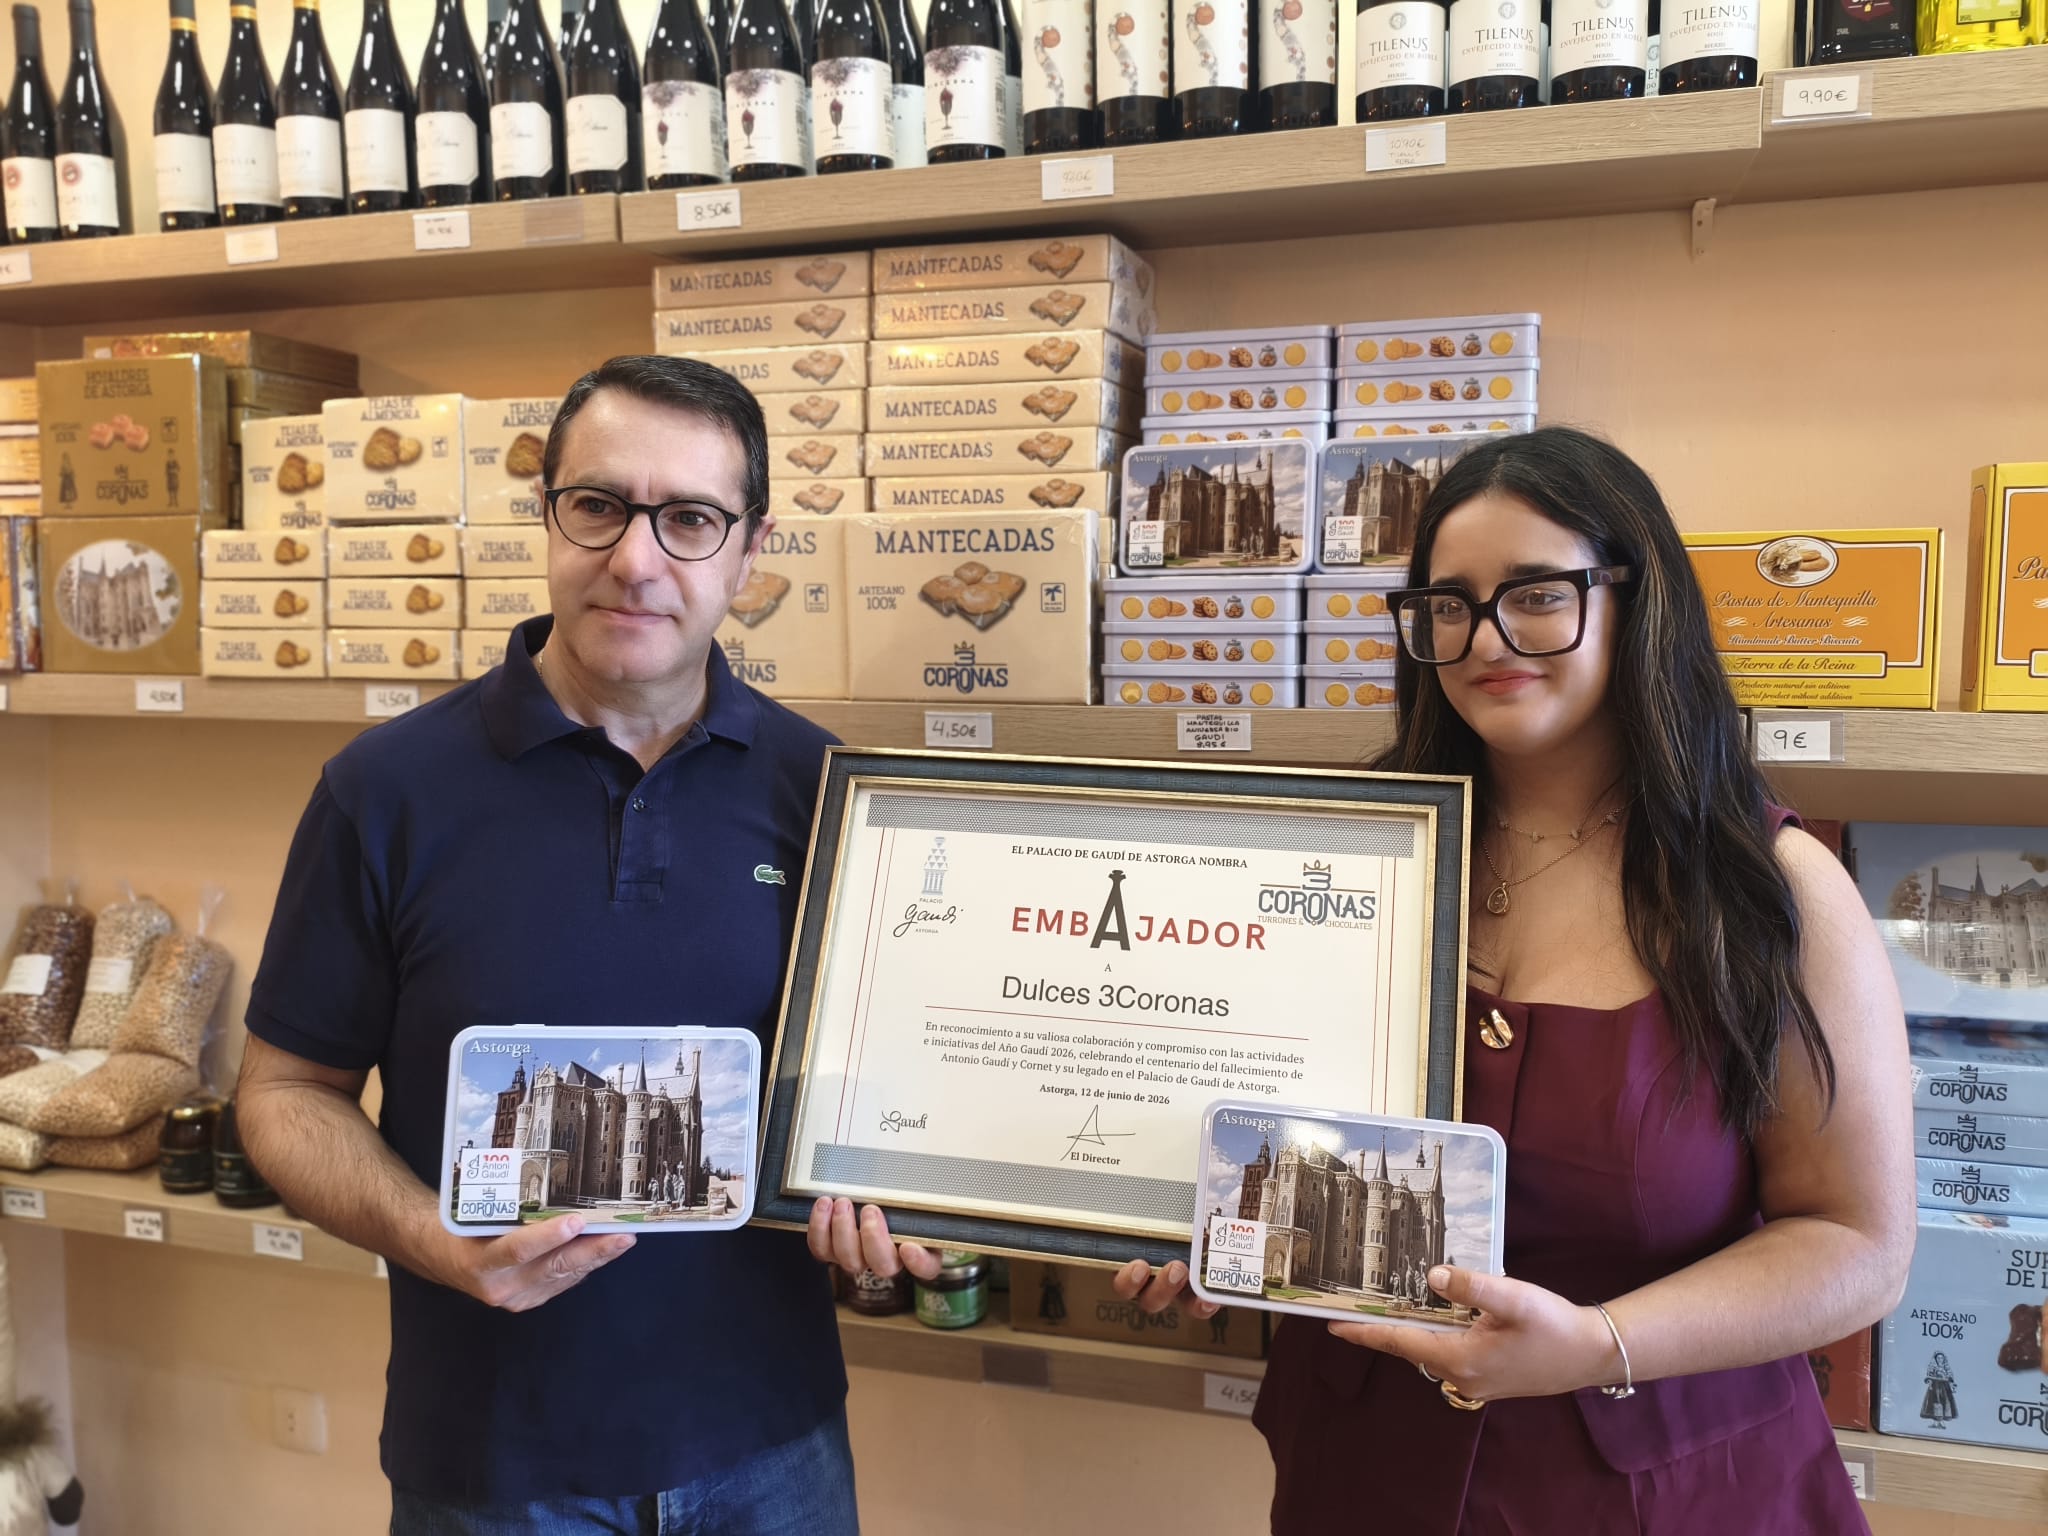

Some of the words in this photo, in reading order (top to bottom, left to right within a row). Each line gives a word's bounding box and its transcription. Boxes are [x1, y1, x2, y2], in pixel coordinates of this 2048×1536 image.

[1682, 5, 1748, 25] TILENUS
[1475, 28, 1533, 44] TILENUS
[1572, 16, 1634, 36] TILENUS
[1369, 37, 1428, 56] TILENUS
[890, 255, 1003, 278] MANTECADAS
[669, 270, 772, 293] MANTECADAS
[891, 302, 1005, 324] MANTECADAS
[669, 315, 772, 338] MANTECADAS
[887, 350, 1000, 371] MANTECADAS
[509, 402, 541, 415] TEJAS
[885, 397, 997, 418] MANTECADAS
[881, 442, 993, 461] MANTECADAS
[1330, 446, 1367, 457] Astorga
[892, 488, 1004, 507] MANTECADAS
[875, 527, 1056, 554] MANTECADAS
[859, 585, 904, 596] ARTESANO
[866, 597, 896, 610] 100%
[1712, 591, 1764, 609] Pastas
[1767, 591, 1785, 607] de
[1786, 590, 1879, 613] Mantequilla
[1753, 611, 1833, 629] Artesanas
[1728, 634, 1781, 646] Handmade
[1783, 635, 1817, 645] Butter
[1820, 634, 1861, 646] Biscuits
[954, 650, 975, 666] 3
[1734, 658, 1775, 671] Tierra
[1778, 657, 1795, 670] de
[1797, 657, 1811, 670] la
[1813, 657, 1856, 670] Reina
[924, 665, 1008, 694] CORONAS
[1735, 680, 1772, 689] Producto
[1773, 681, 1803, 689] natural
[1818, 681, 1851, 690] aditivos
[1773, 730, 1788, 750] 9
[1793, 732, 1807, 749] €
[1012, 845, 1024, 855] EL
[1026, 846, 1072, 858] PALACIO
[1074, 849, 1089, 859] DE
[1091, 850, 1125, 861] GAUDÍ
[1128, 852, 1142, 862] DE
[1144, 853, 1196, 865] ASTORGA
[1199, 857, 1248, 868] NOMBRA
[1302, 871, 1332, 891] 3
[1012, 869, 1266, 951] EMBAJADOR
[1258, 889, 1375, 925] CORONAS
[1257, 915, 1296, 925] TURRONES
[1298, 917, 1304, 925] &
[1324, 919, 1373, 930] CHOCOLATES
[1104, 963, 1112, 973] A
[1002, 975, 1091, 1005] Dulces
[1098, 984, 1230, 1017] 3Coronas
[469, 1040, 531, 1058] Astorga
[925, 1021, 938, 1031] En
[940, 1024, 1013, 1038] reconocimiento
[1023, 1032, 1034, 1040] su
[1036, 1032, 1070, 1043] valiosa
[1072, 1034, 1135, 1049] colaboración
[1137, 1042, 1143, 1050] y
[1145, 1041, 1207, 1055] compromiso
[1209, 1048, 1228, 1057] con
[1230, 1048, 1244, 1059] las
[1246, 1050, 1305, 1064] actividades
[923, 1038, 929, 1046] e
[931, 1037, 979, 1050] iniciativas
[981, 1041, 996, 1052] del
[998, 1043, 1018, 1053] Año
[1020, 1045, 1048, 1056] Gaudí
[1050, 1047, 1077, 1059] 2026,
[1079, 1052, 1133, 1066] celebrando
[1135, 1055, 1144, 1065] el
[1146, 1058, 1200, 1071] centenario
[1202, 1062, 1218, 1072] del
[1220, 1062, 1288, 1078] fallecimiento
[1290, 1069, 1304, 1080] de
[941, 1053, 980, 1065] Antonio
[982, 1056, 1010, 1068] Gaudí
[1011, 1060, 1018, 1070] y
[1020, 1060, 1053, 1071] Cornet
[1055, 1065, 1061, 1074] y
[1063, 1065, 1074, 1073] su
[1076, 1065, 1109, 1078] legado
[1111, 1070, 1123, 1078] en
[1126, 1070, 1135, 1079] el
[1137, 1071, 1173, 1083] Palacio
[1176, 1075, 1188, 1084] de
[1190, 1076, 1220, 1088] Gaudí
[1222, 1079, 1235, 1089] de
[1237, 1081, 1280, 1094] Astorga.
[1040, 1084, 1077, 1096] Astorga,
[1081, 1087, 1091, 1097] 12
[1093, 1089, 1105, 1098] de
[1106, 1090, 1132, 1102] junio
[1134, 1092, 1145, 1102] de
[1147, 1094, 1170, 1105] 2026
[1930, 1082, 2008, 1104] CORONAS
[1219, 1111, 1276, 1133] Astorga
[1928, 1131, 2006, 1153] CORONAS
[1070, 1151, 1080, 1161] El
[1082, 1153, 1120, 1165] Director
[1932, 1182, 2010, 1206] CORONAS
[461, 1202, 516, 1217] CORONAS
[1229, 1232, 1255, 1241] Antoni
[1209, 1269, 1261, 1288] CORONAS
[2006, 1269, 2035, 1288] DE
[1910, 1308, 1976, 1325] ARTESANO
[1921, 1323, 1964, 1340] 100%
